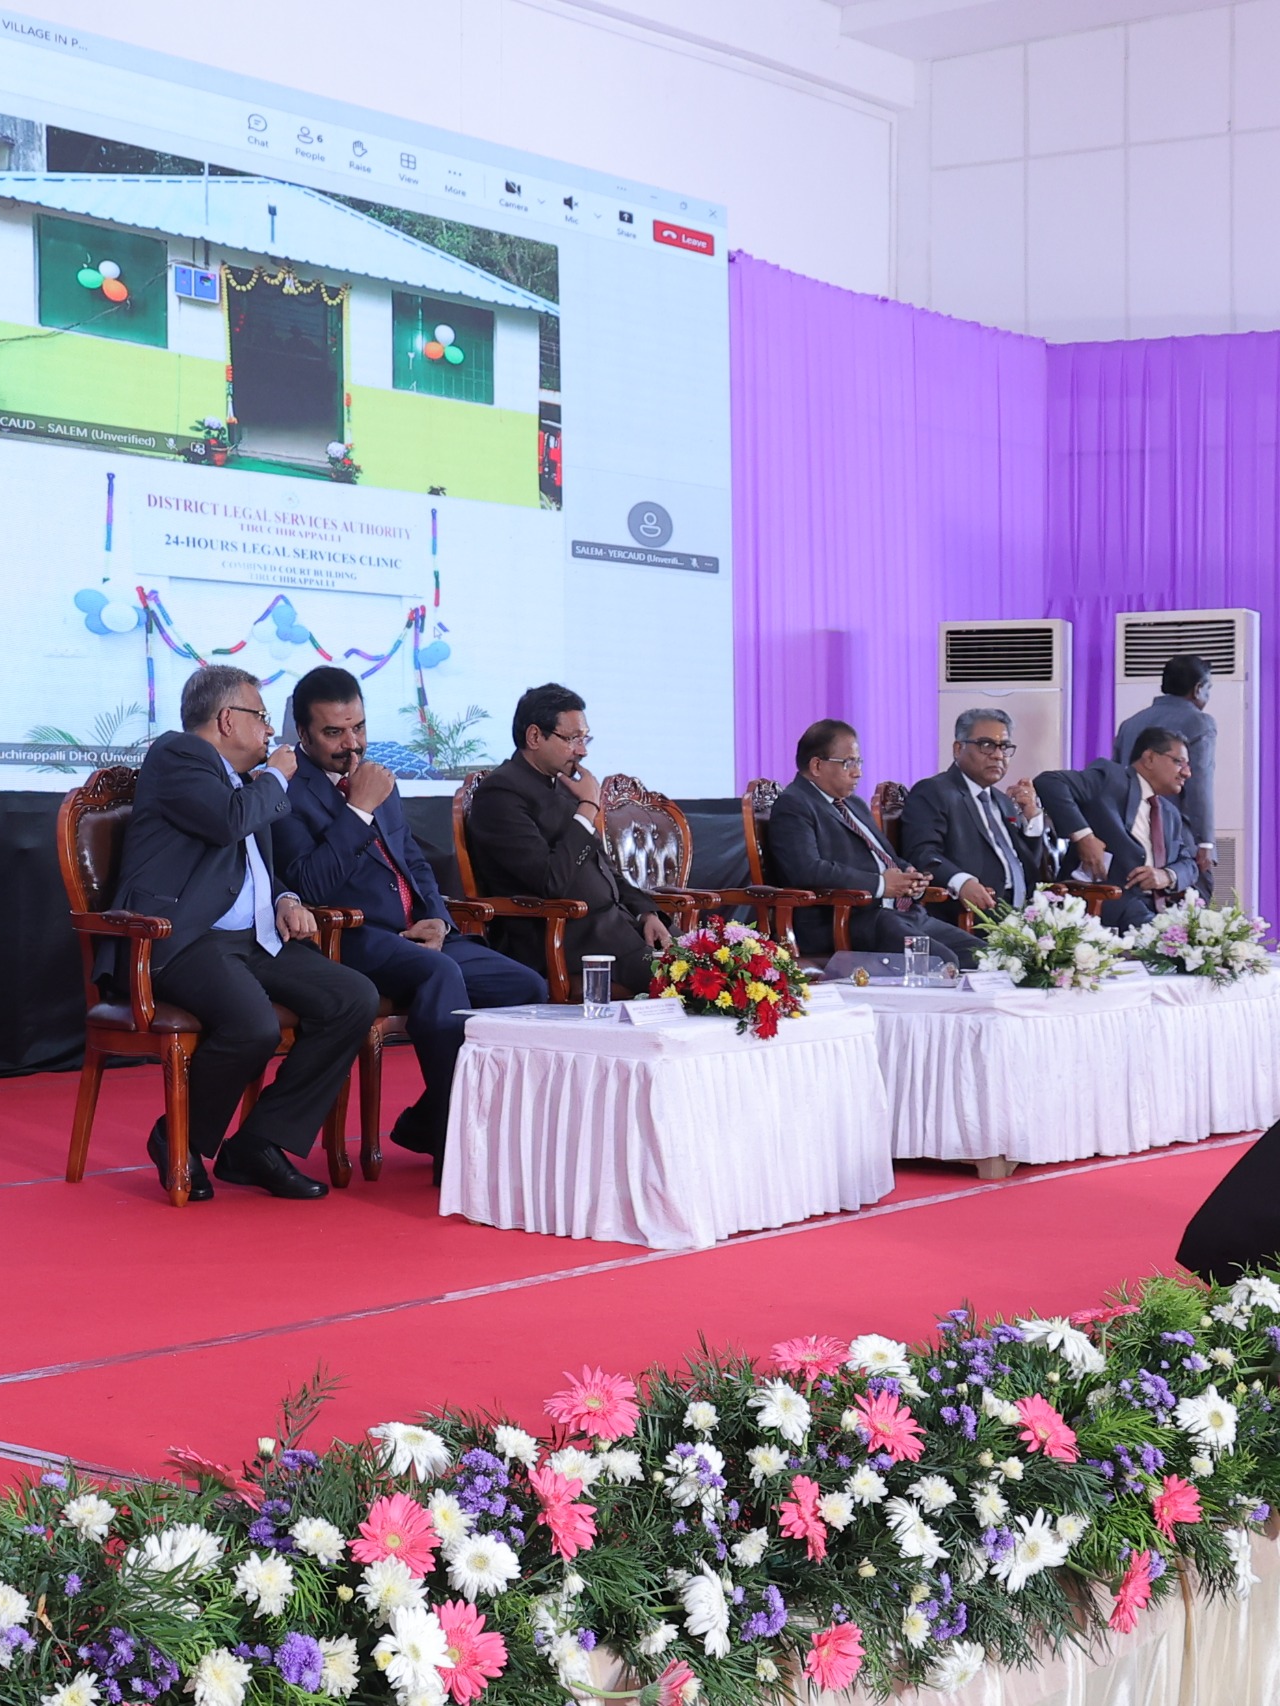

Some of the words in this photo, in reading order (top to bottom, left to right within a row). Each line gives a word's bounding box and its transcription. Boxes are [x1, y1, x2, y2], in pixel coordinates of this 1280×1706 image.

[2, 19, 51, 41] VILLAGE
[55, 33, 67, 45] IN
[247, 135, 269, 149] Chat
[317, 134, 324, 143] 6
[295, 147, 326, 163] People
[349, 161, 372, 174] Raise
[399, 173, 419, 186] View
[445, 185, 467, 198] More
[499, 198, 529, 213] Camera
[565, 214, 579, 226] Mic
[617, 227, 637, 240] Share
[681, 233, 708, 249] Leave
[48, 422, 88, 439] SALEM
[91, 428, 156, 448] (Unverified)
[147, 493, 220, 516] DISTRICT
[224, 504, 272, 523] LEGAL
[274, 510, 338, 531] SERVICES
[341, 520, 412, 541] AUTHORITY
[165, 533, 238, 552] 24-HOURS
[242, 542, 290, 558] LEGAL
[293, 547, 356, 564] SERVICES
[359, 554, 403, 569] CLINIC
[608, 549, 646, 562] YERCAUD
[70, 750, 99, 763] DHQ
